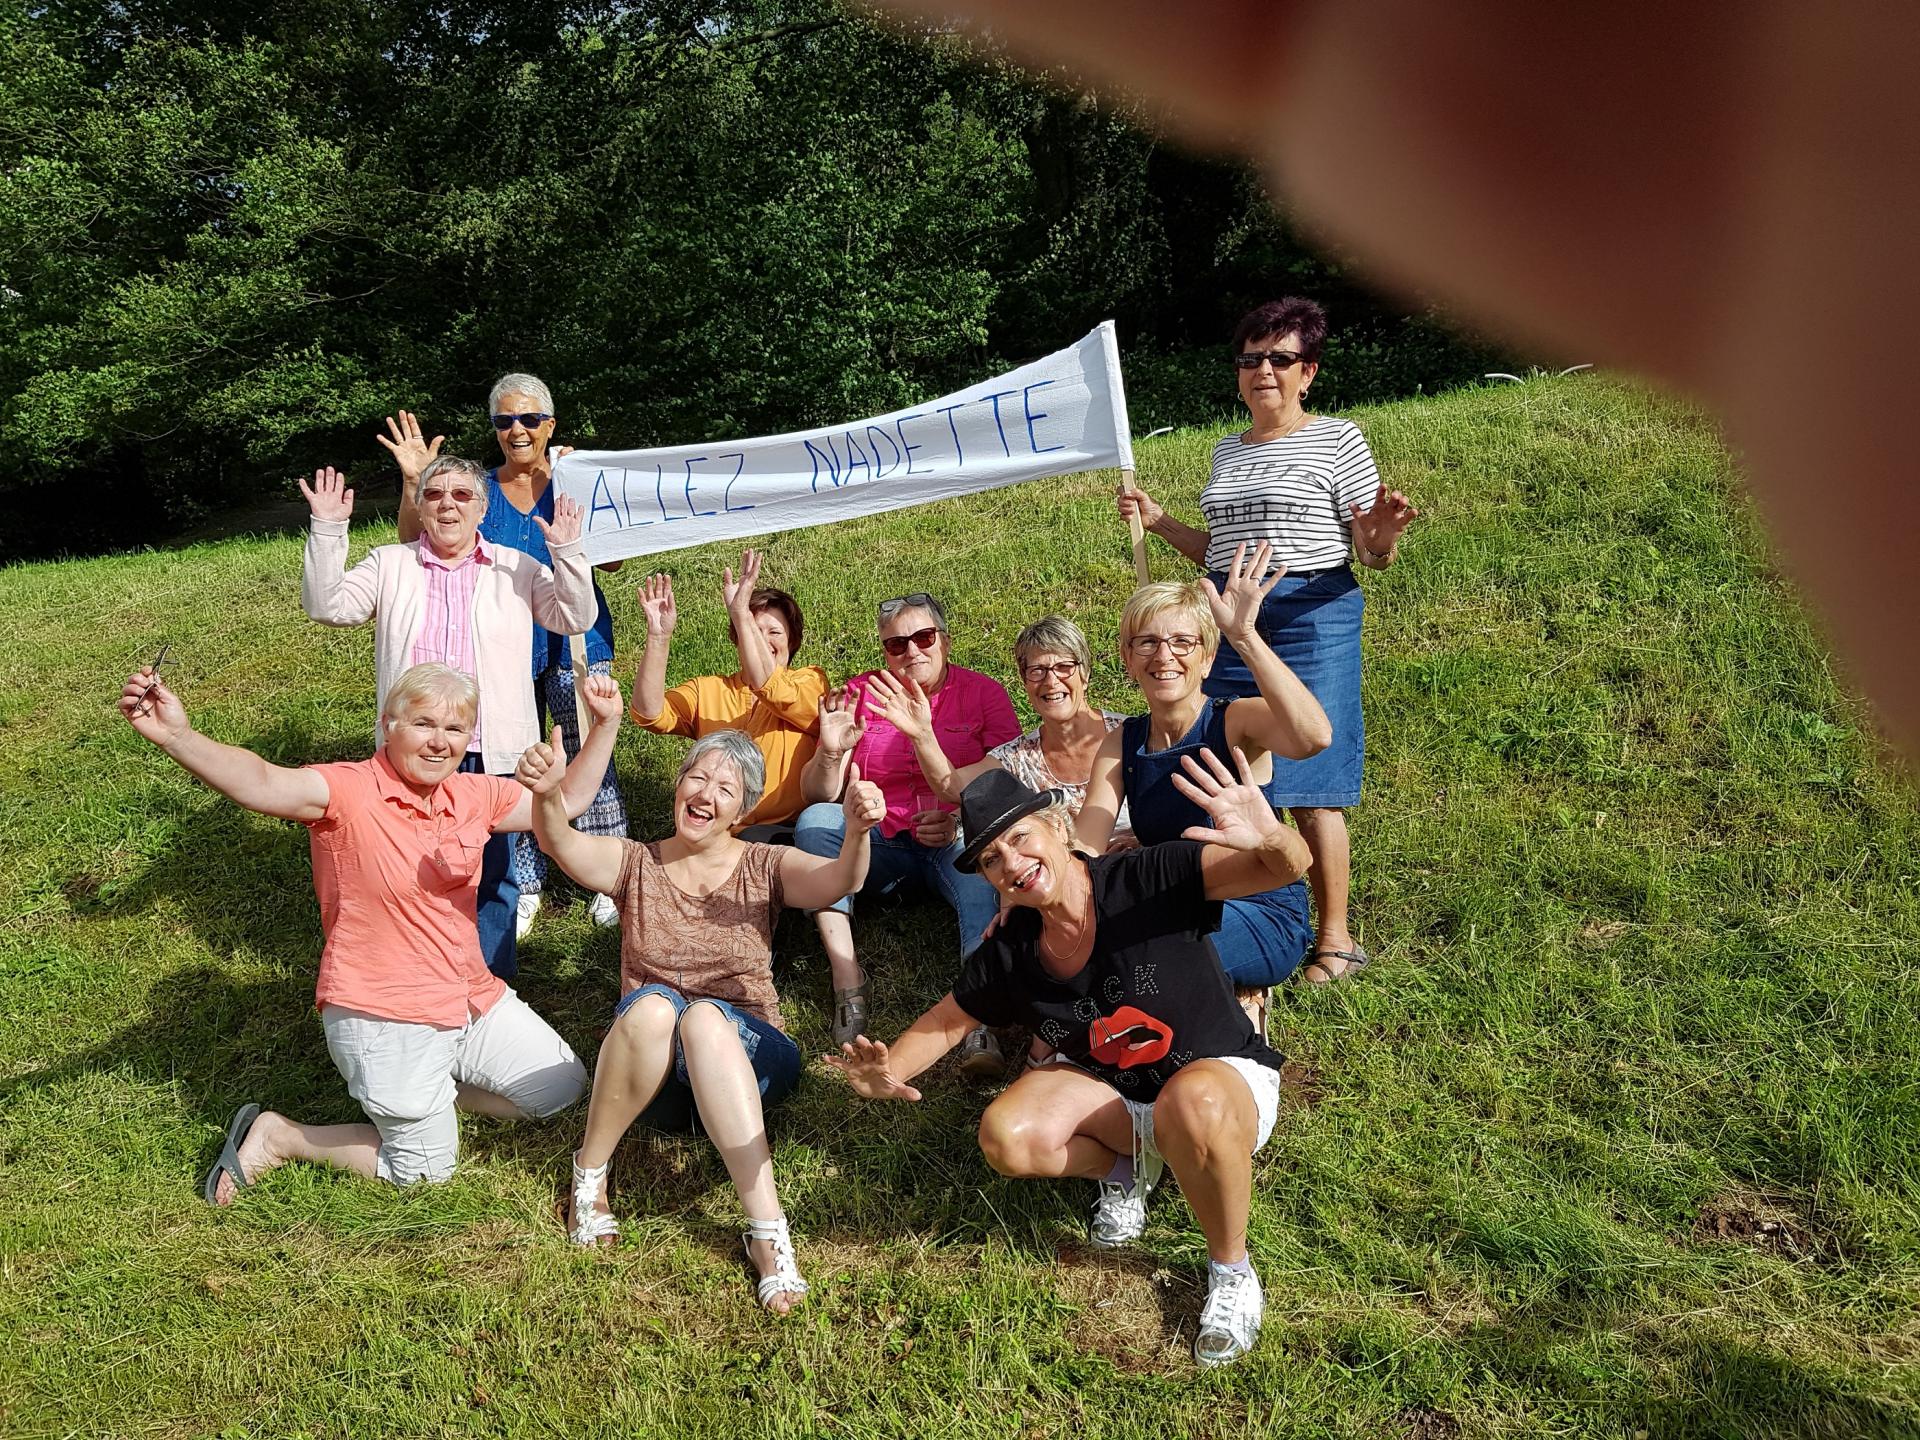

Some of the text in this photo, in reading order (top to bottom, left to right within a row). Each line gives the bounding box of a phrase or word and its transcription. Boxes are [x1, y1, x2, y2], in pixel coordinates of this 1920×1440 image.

[588, 380, 1066, 533] ALLEZ NADETTE
[1040, 963, 1160, 1048] ROCK
